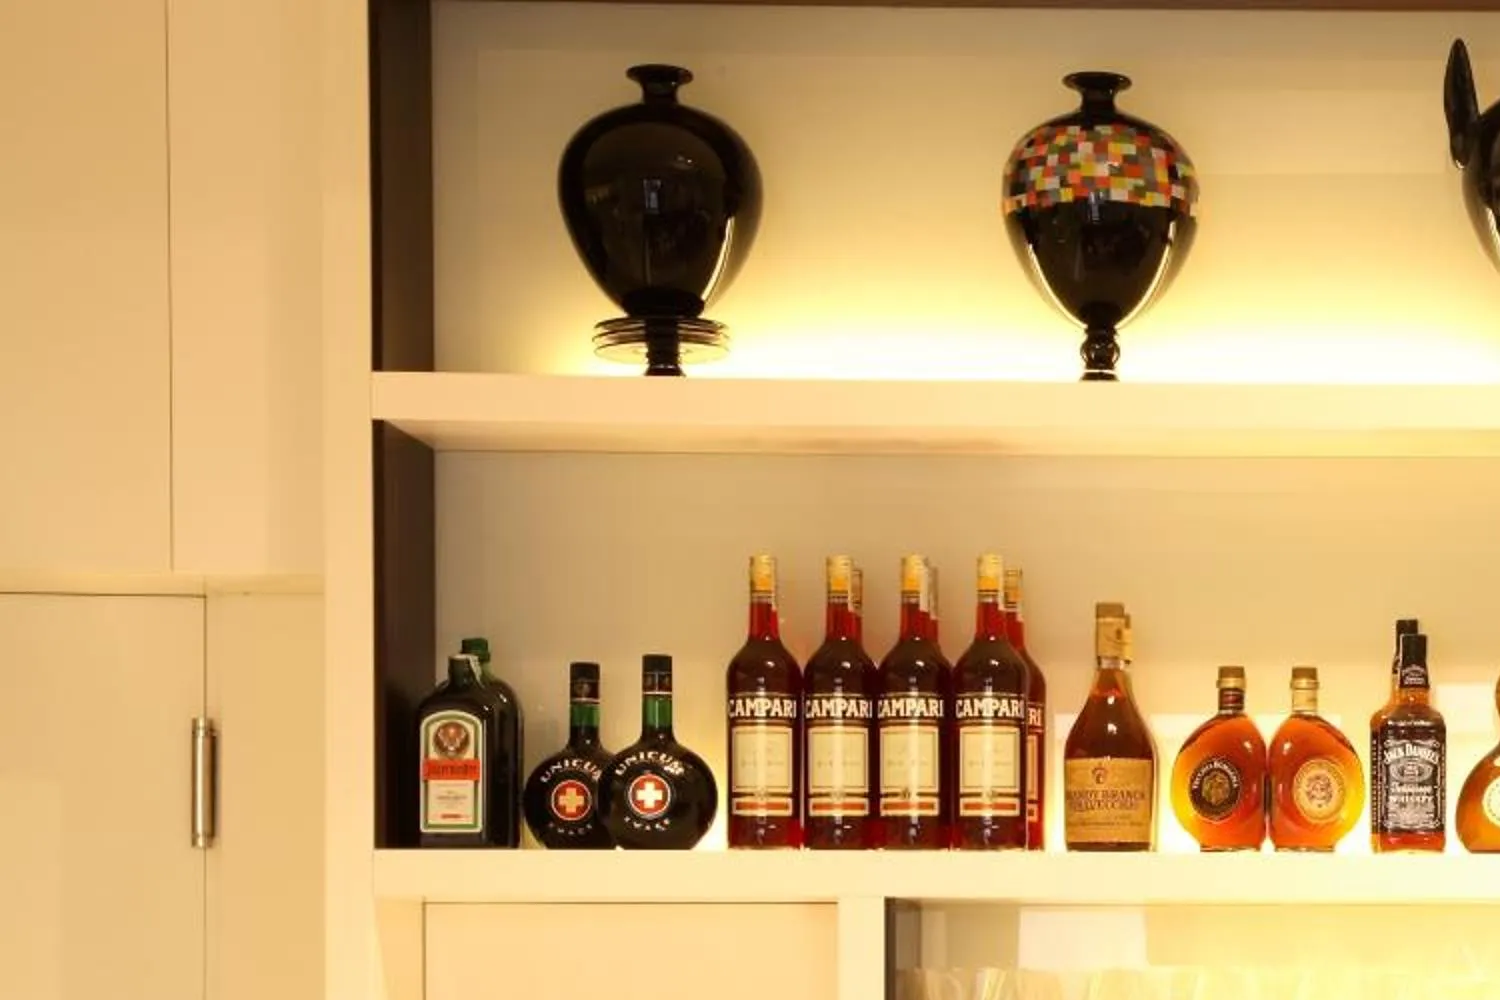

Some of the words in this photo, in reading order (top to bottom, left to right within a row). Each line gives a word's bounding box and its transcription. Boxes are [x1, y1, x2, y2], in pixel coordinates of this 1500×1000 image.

[729, 698, 797, 719] CAMPARI
[805, 698, 873, 719] CAMPARI
[877, 698, 944, 719] CAMPARI
[955, 698, 1025, 719] CAMPARI
[615, 751, 685, 776] UNICUM
